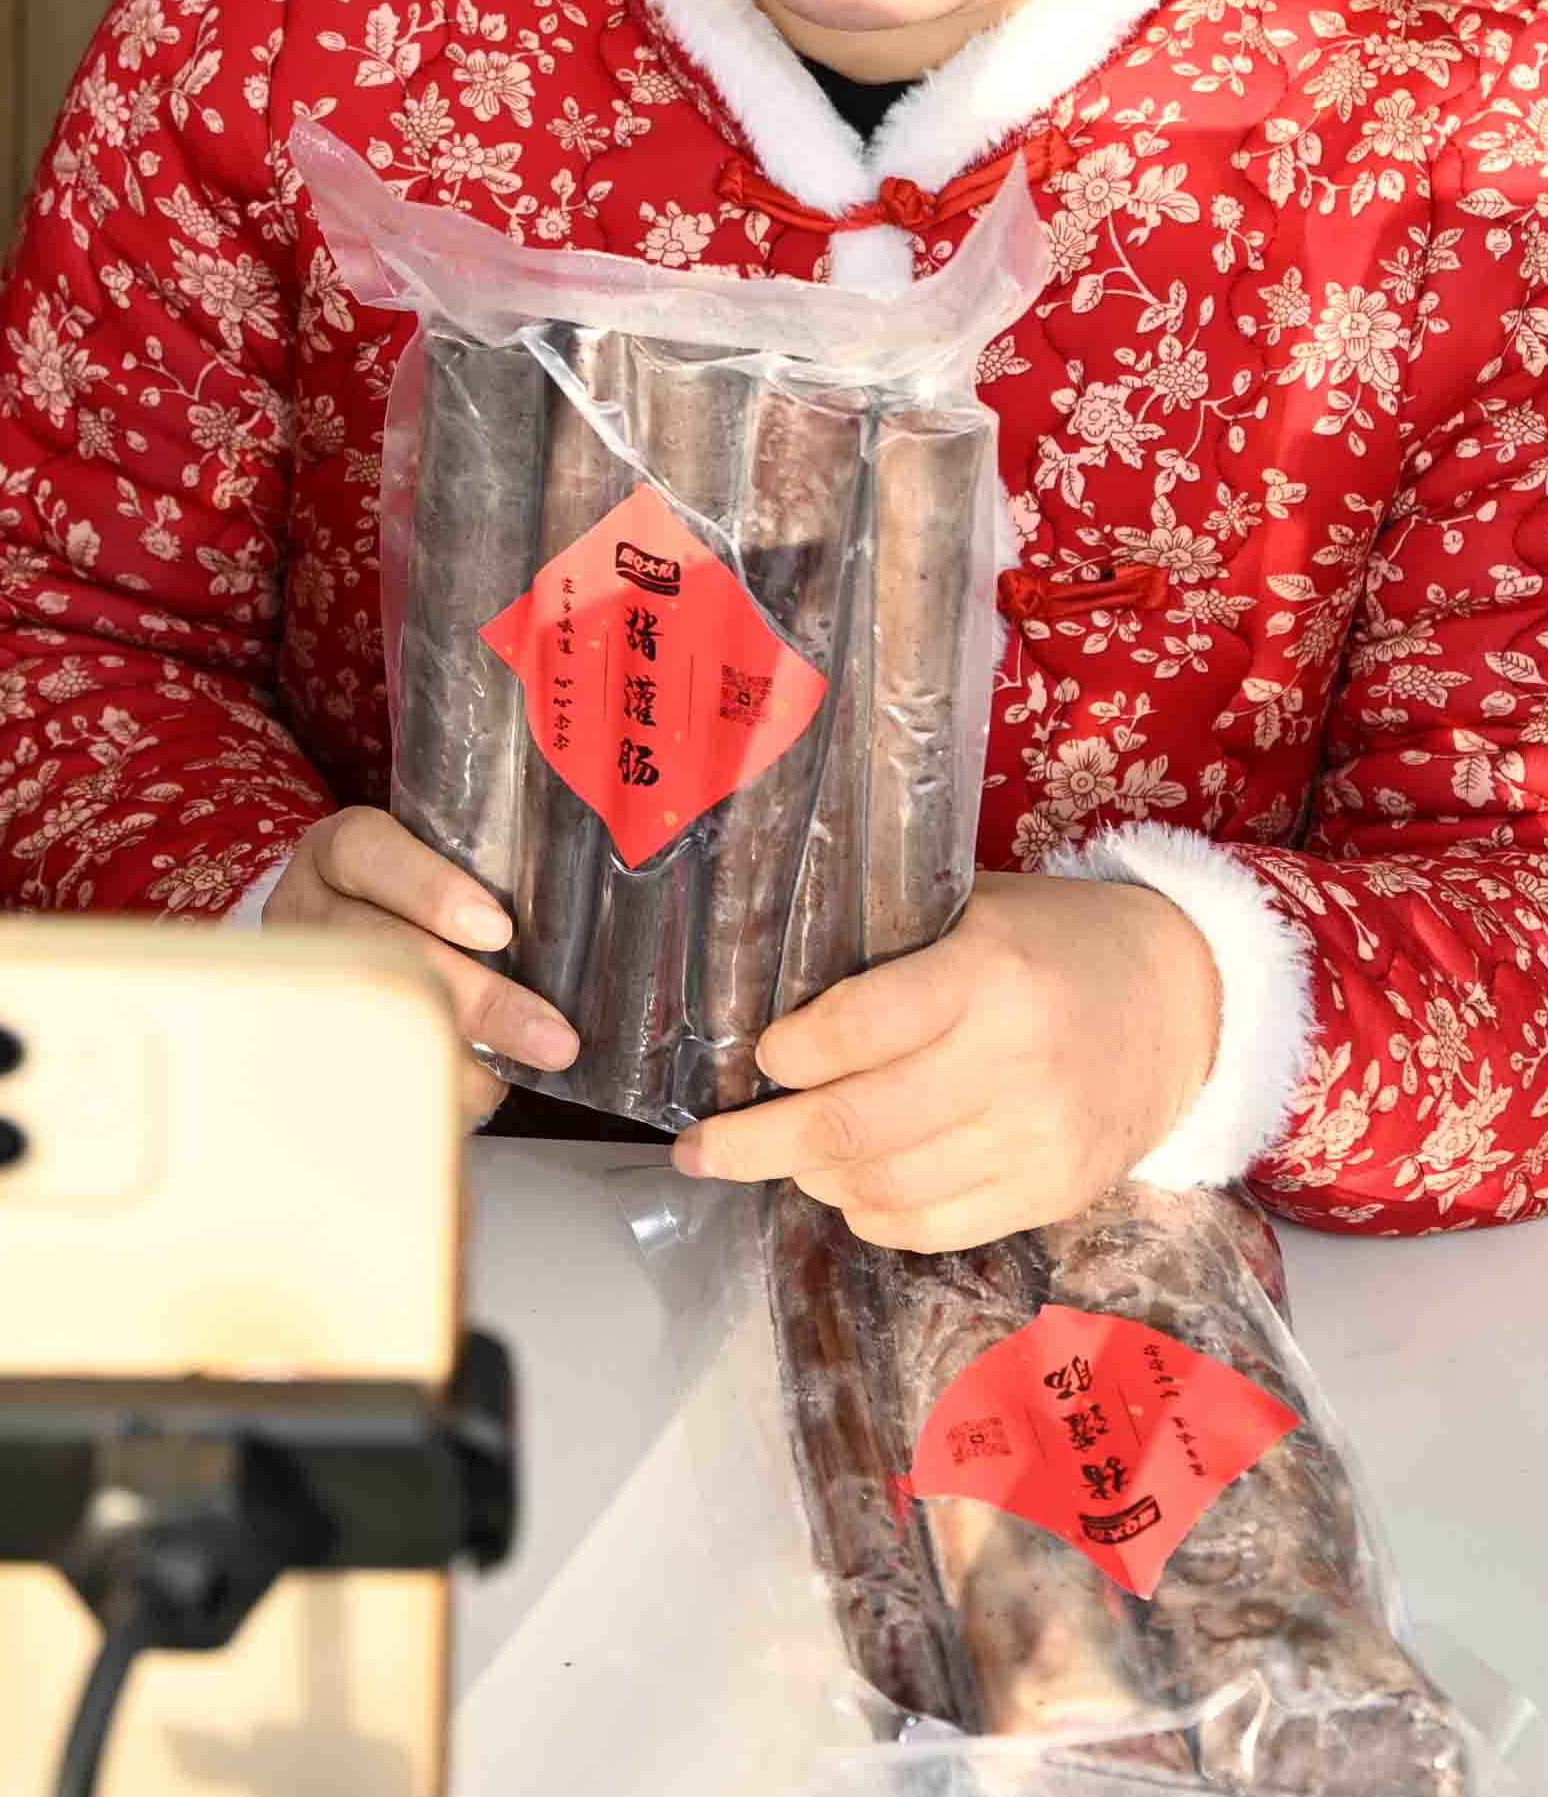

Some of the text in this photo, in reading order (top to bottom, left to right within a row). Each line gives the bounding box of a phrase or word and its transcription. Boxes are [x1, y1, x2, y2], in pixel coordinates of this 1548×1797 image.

[556, 577, 576, 655] 家乡味道
[617, 607, 663, 787] 猪灌肠
[1043, 1356, 1130, 1501] 猪灌肠
